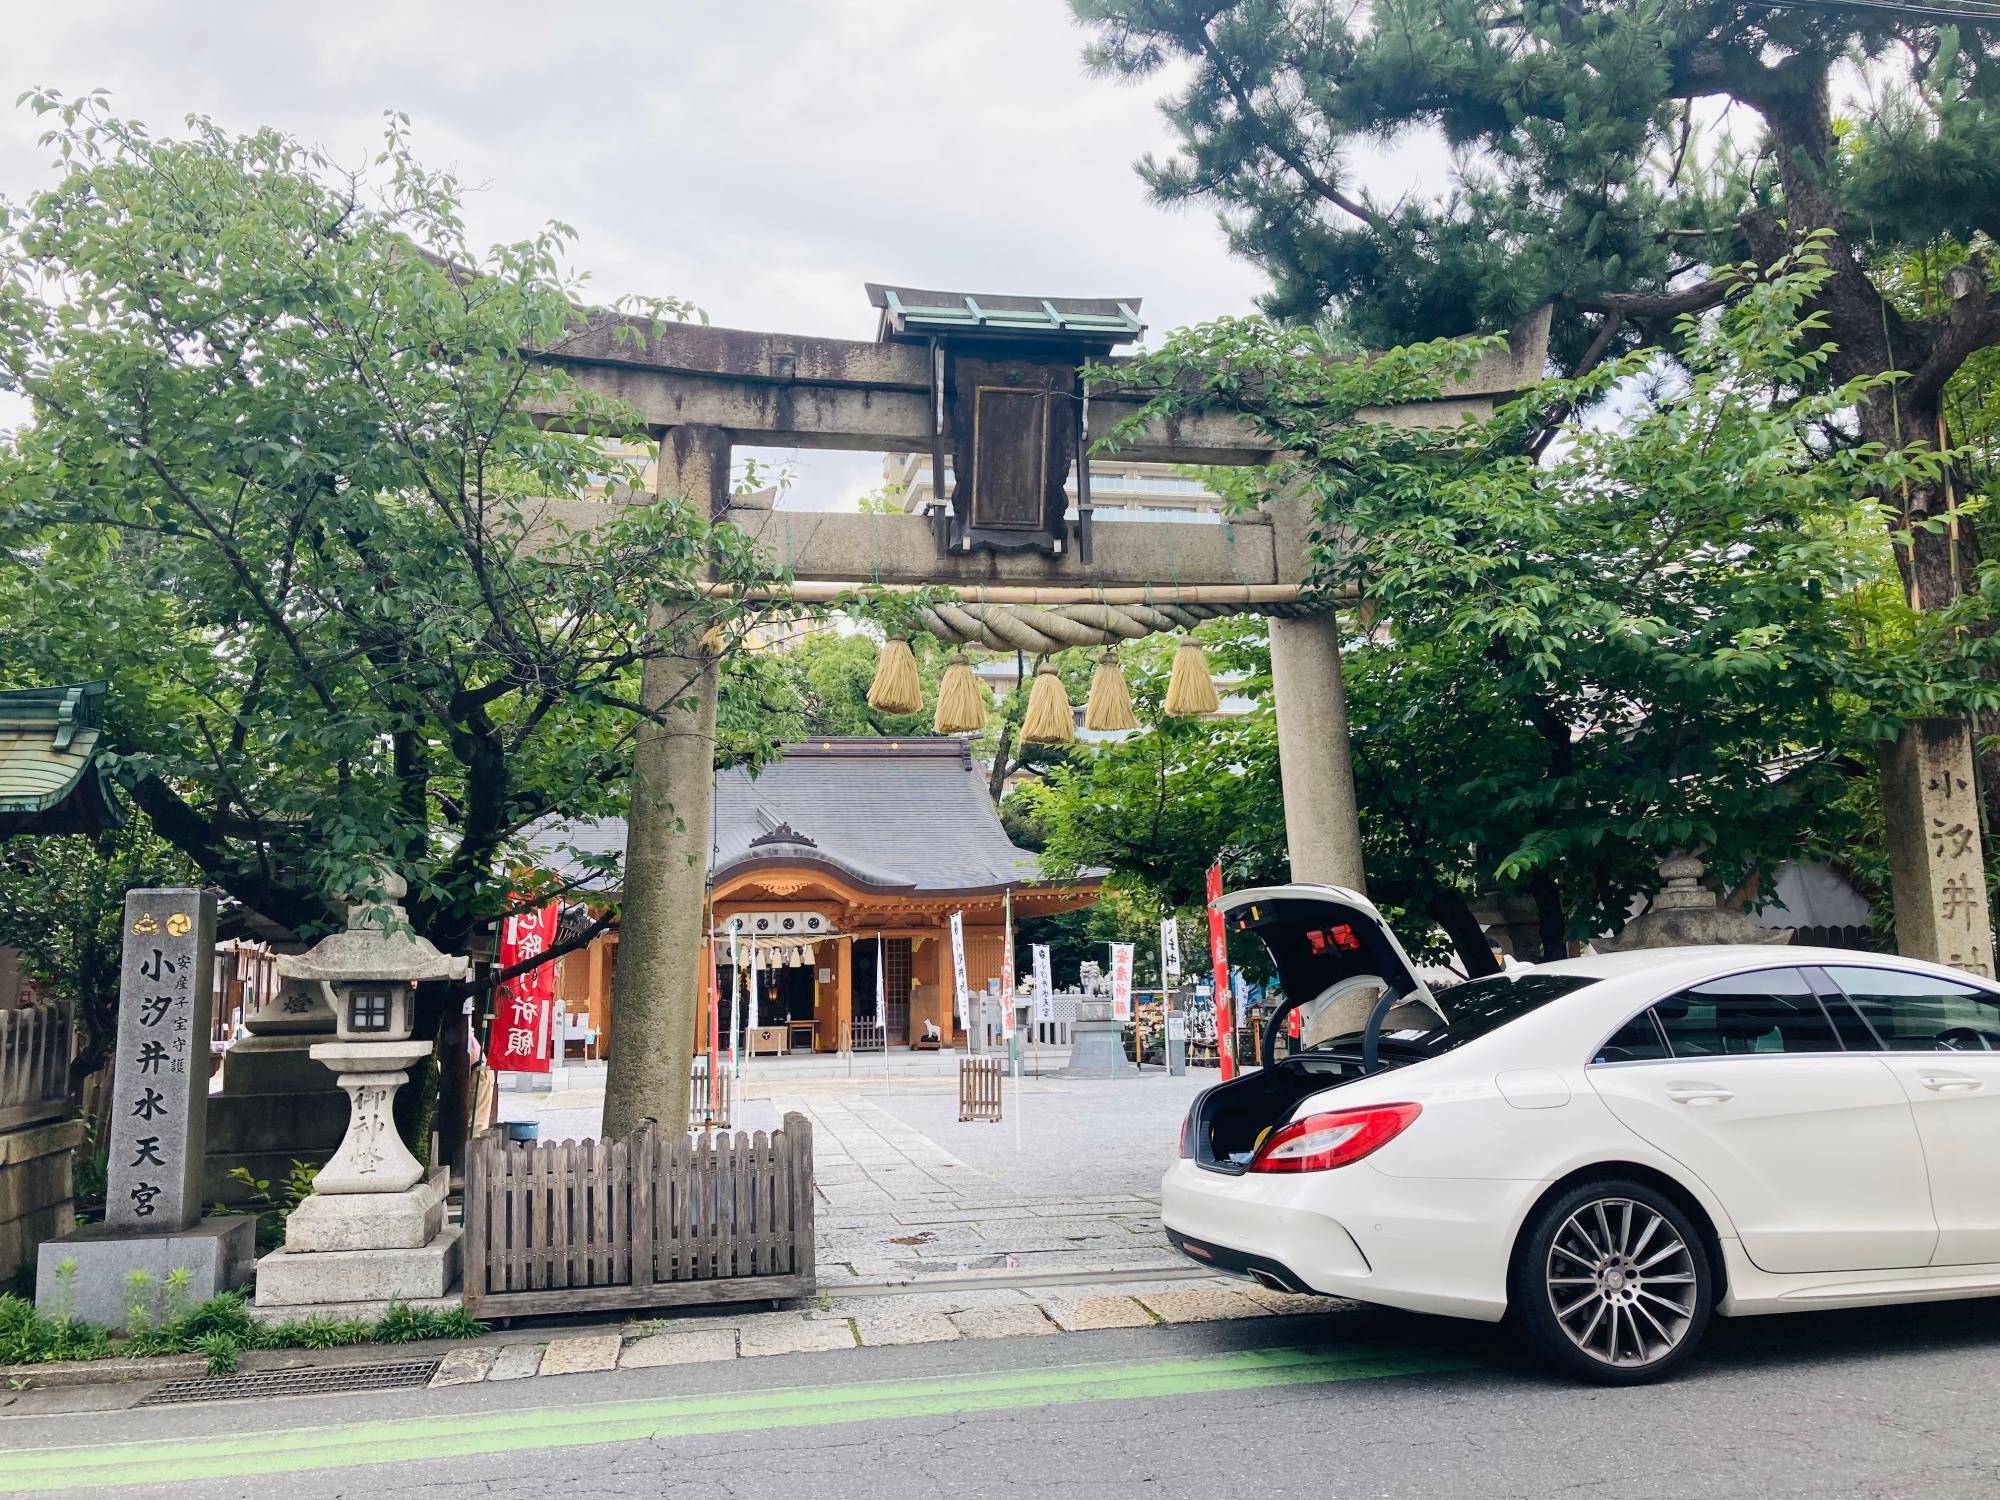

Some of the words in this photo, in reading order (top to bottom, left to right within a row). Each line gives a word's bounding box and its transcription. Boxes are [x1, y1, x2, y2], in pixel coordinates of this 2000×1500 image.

[170, 954, 192, 1074] 安産子宝守護
[129, 948, 176, 1218] 小汐井水天宮
[352, 1085, 388, 1174] 御神燈
